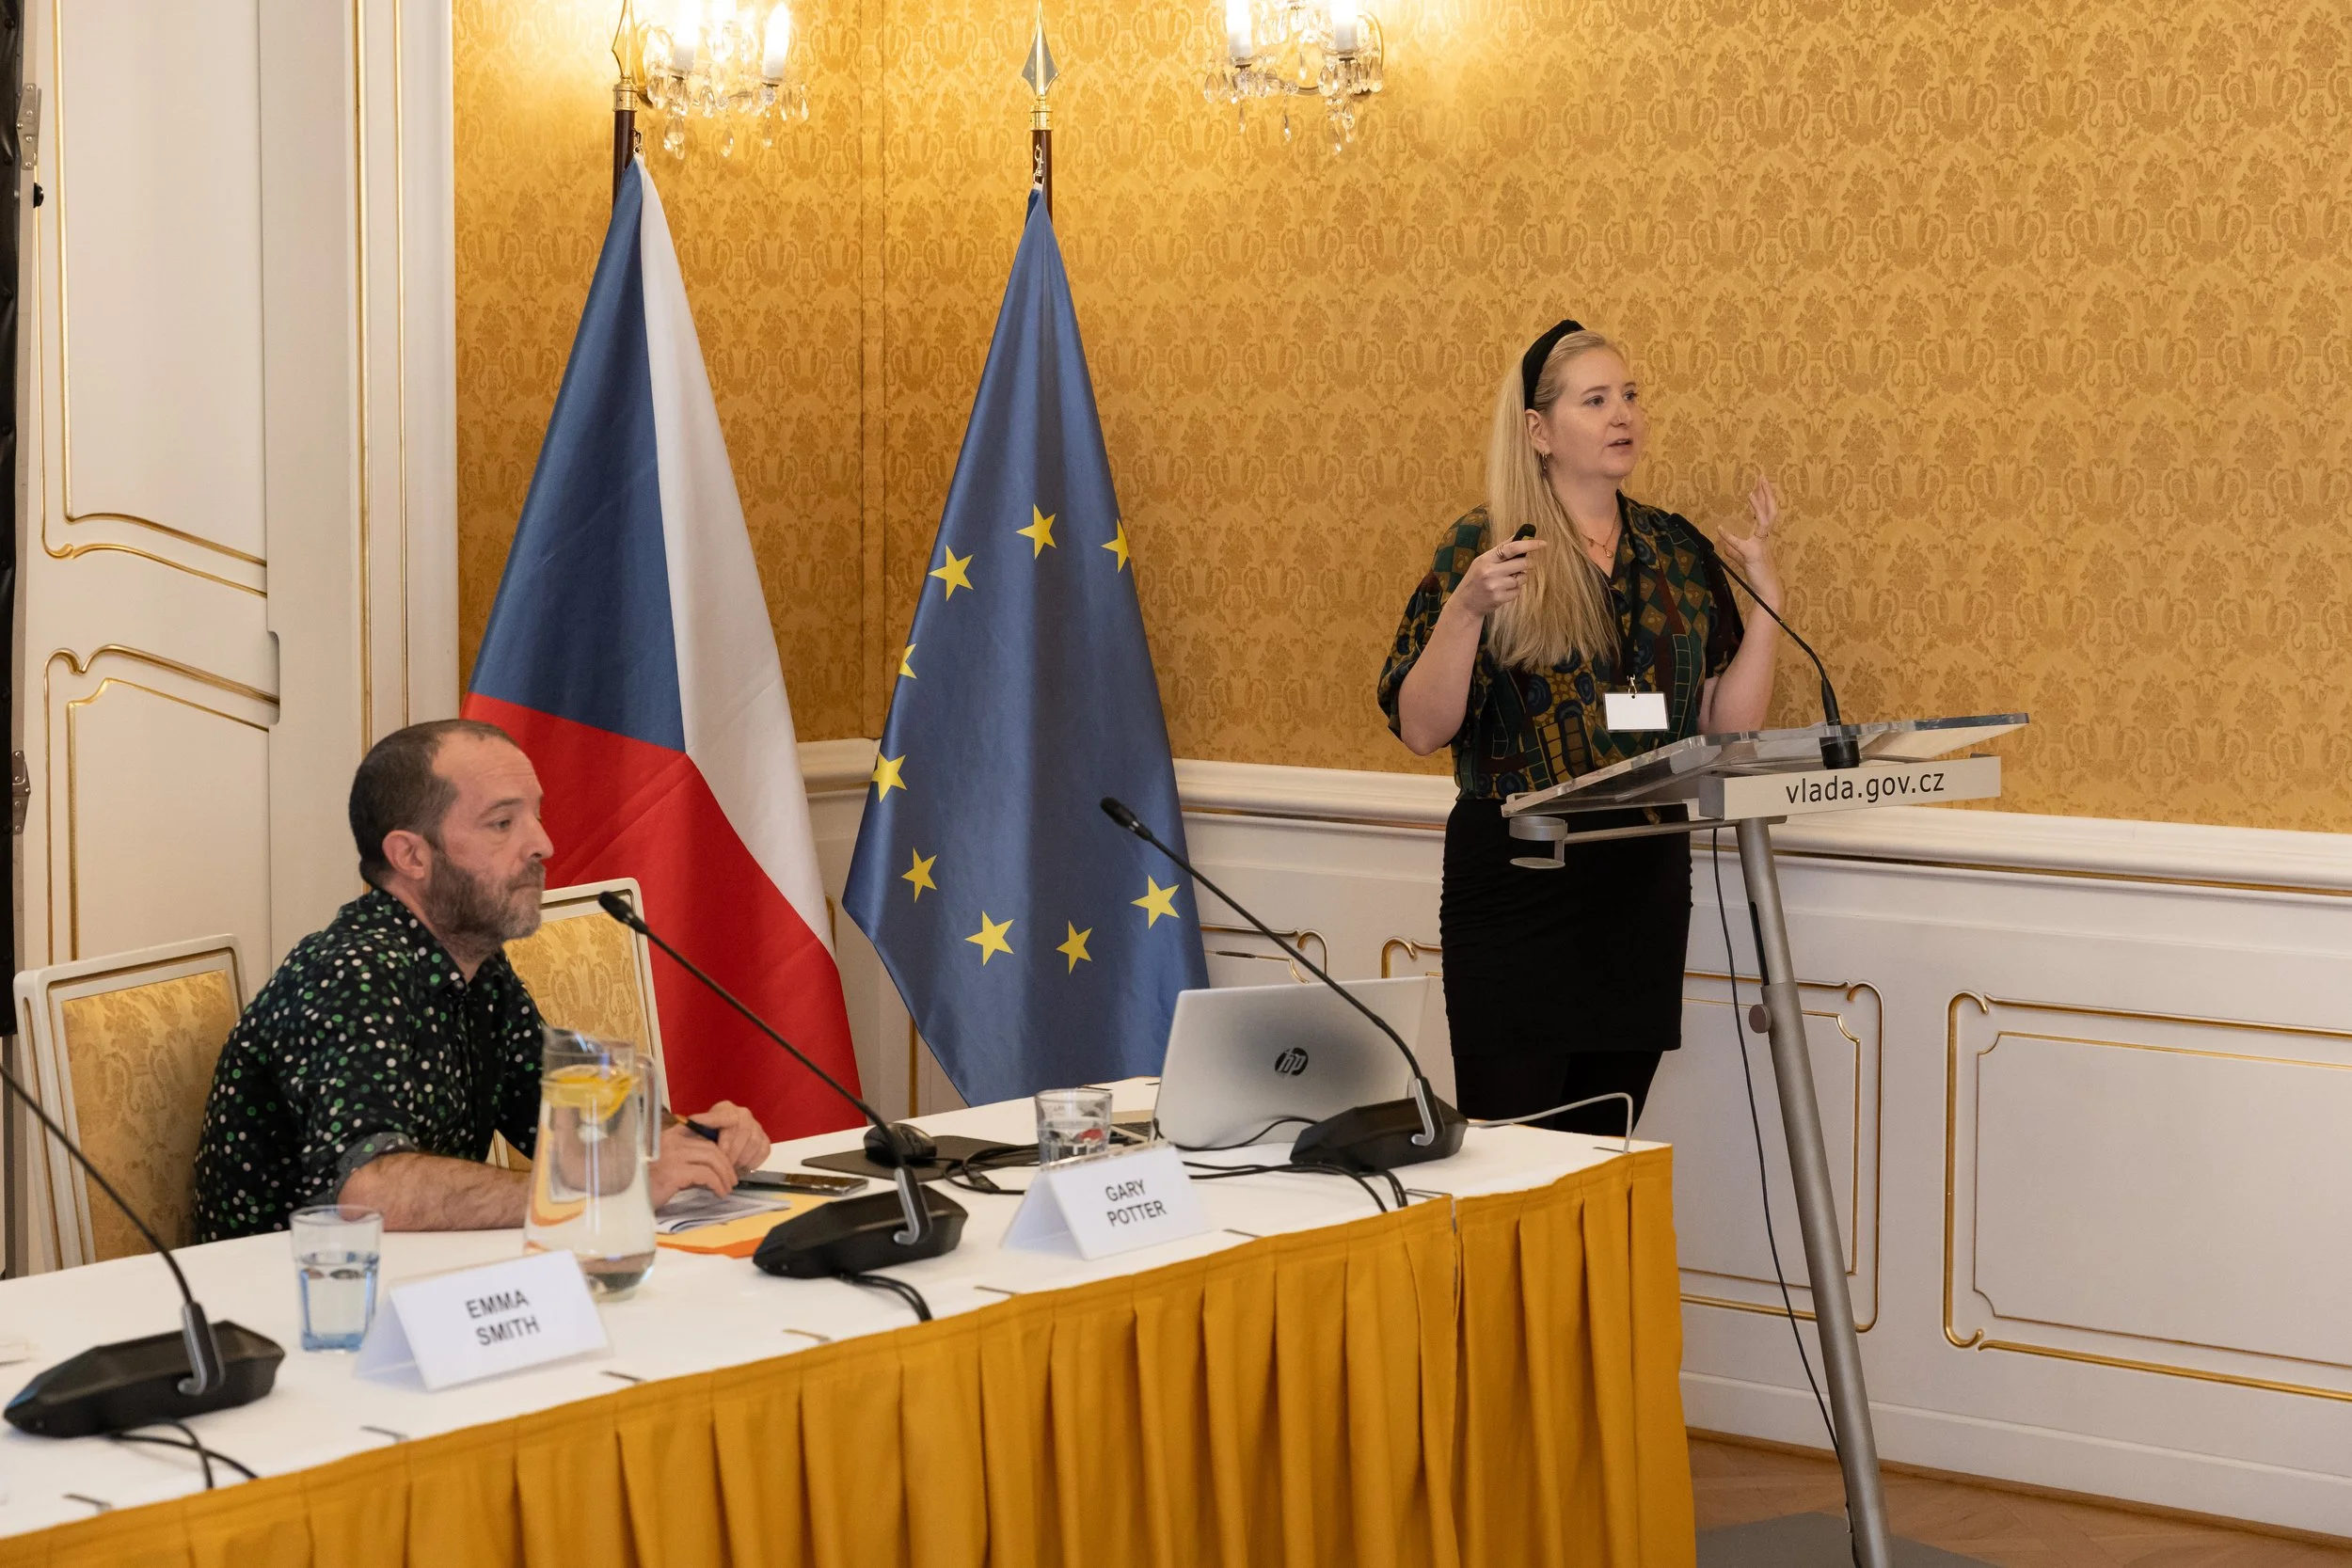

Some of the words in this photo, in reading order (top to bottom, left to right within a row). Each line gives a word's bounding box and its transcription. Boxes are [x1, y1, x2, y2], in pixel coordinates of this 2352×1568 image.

[1786, 773, 1945, 803] vlada.gov.cz
[1275, 1047, 1309, 1078] hp
[1105, 1180, 1146, 1201] GARY
[1106, 1200, 1168, 1227] POTTER
[466, 1290, 529, 1319] EMMA
[476, 1315, 541, 1345] SMITH
